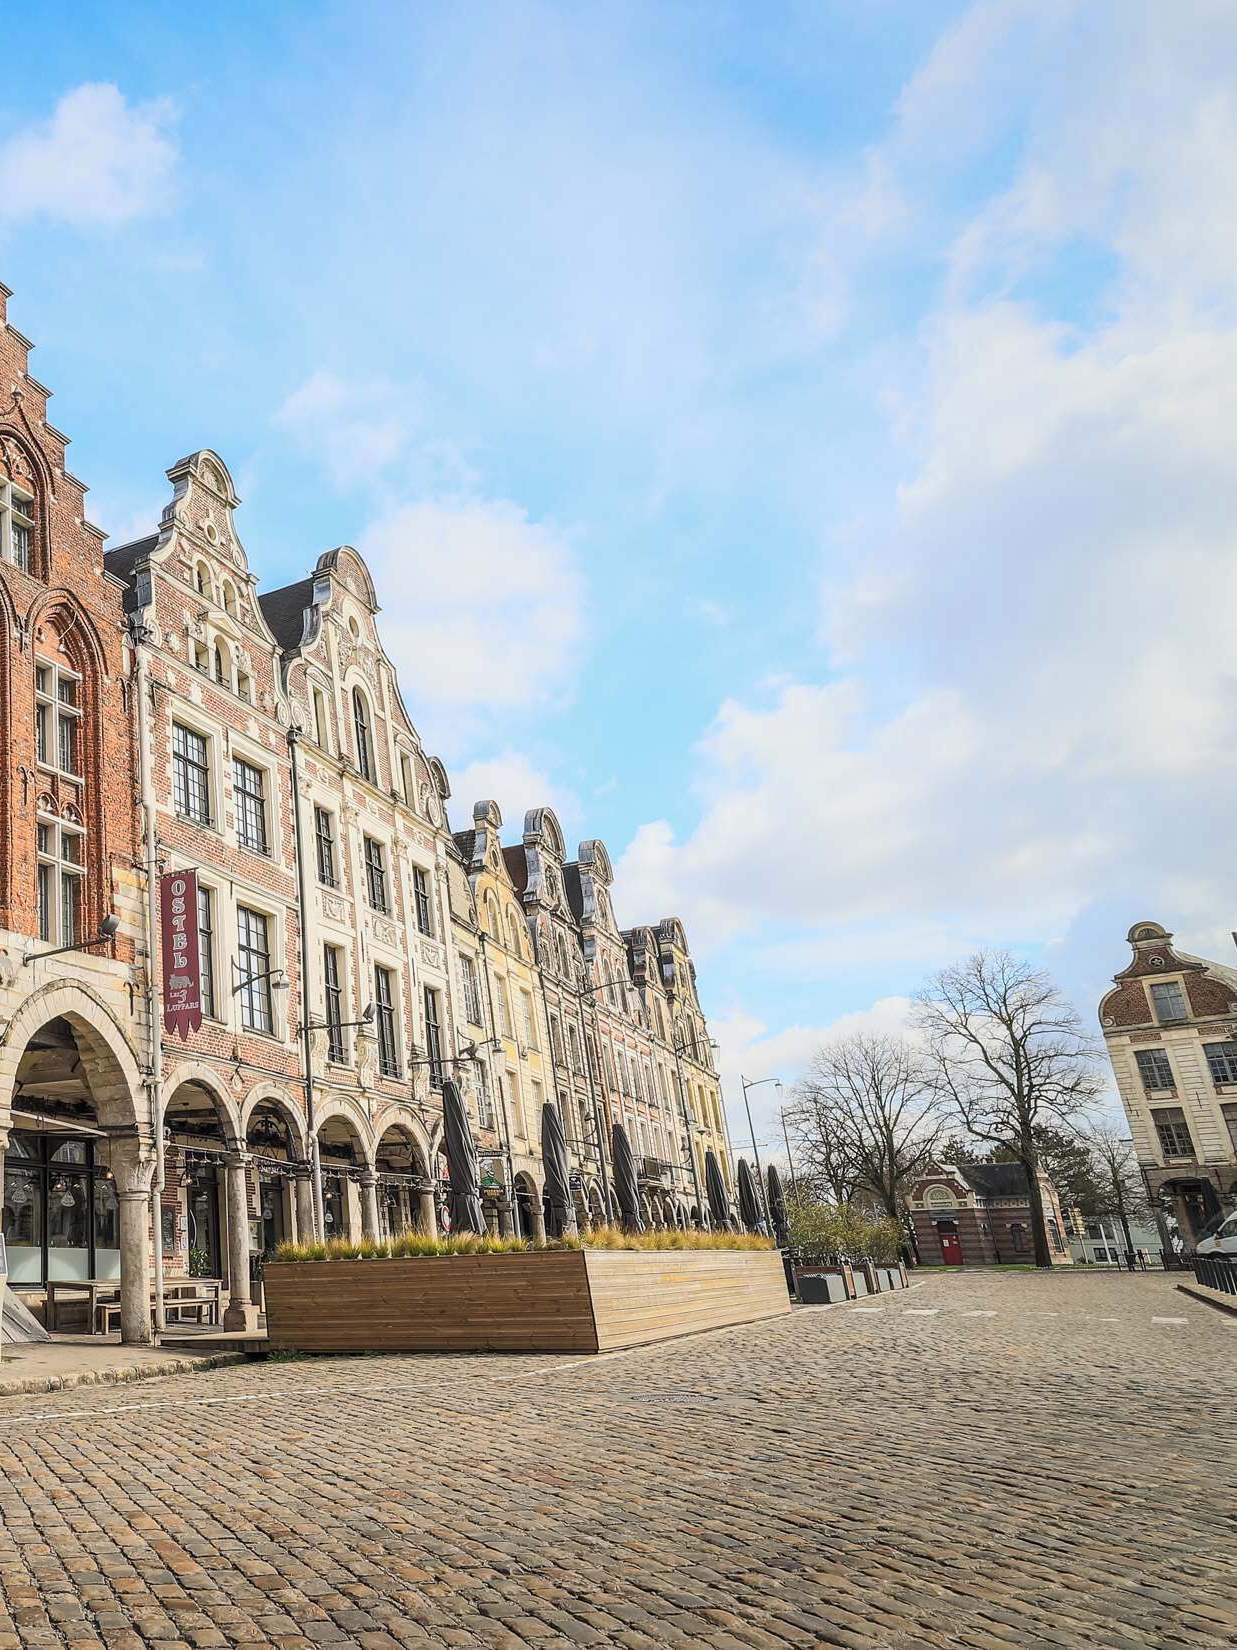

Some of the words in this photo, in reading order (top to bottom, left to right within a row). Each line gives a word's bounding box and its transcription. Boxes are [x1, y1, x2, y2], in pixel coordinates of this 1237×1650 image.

[171, 879, 188, 969] OSTEL
[177, 990, 188, 1004] 3
[167, 1001, 199, 1012] LUPPARS
